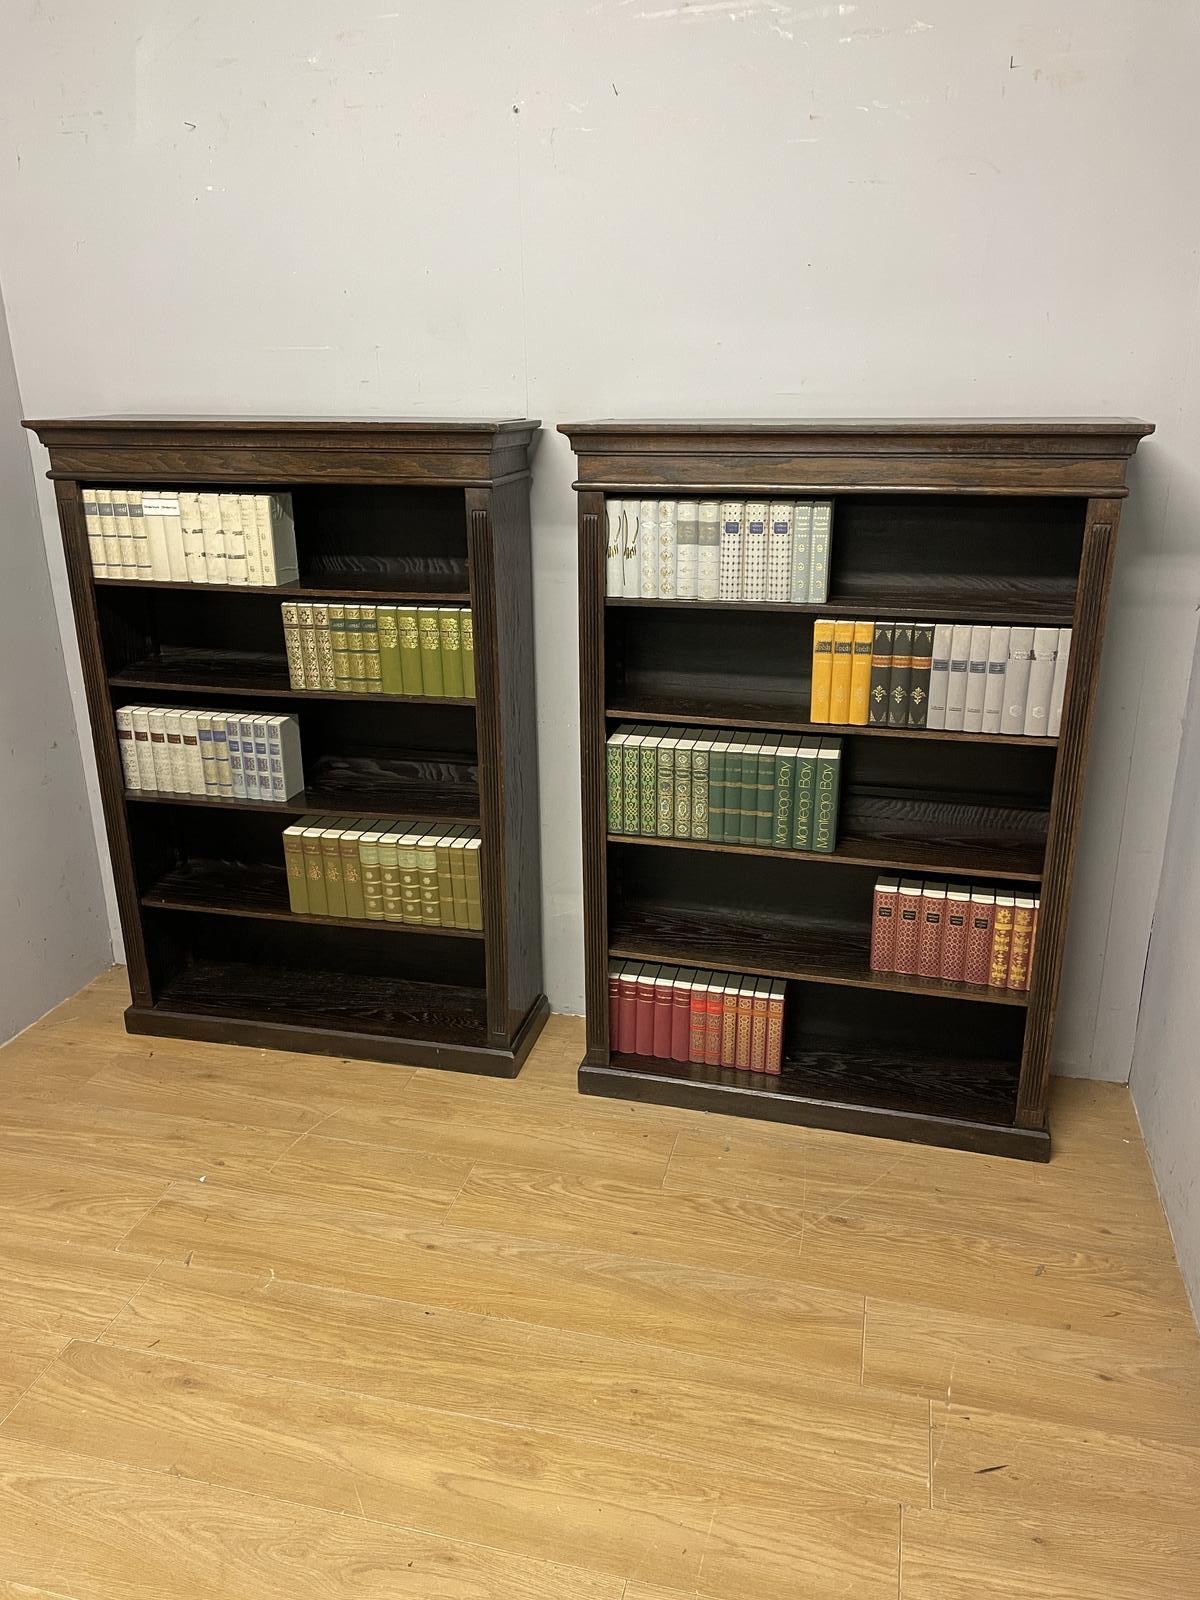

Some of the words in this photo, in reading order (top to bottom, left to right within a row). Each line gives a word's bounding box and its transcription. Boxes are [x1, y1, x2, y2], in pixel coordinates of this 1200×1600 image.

[778, 760, 794, 787] Bay
[798, 761, 815, 788] Bay
[819, 763, 836, 790] Bay
[775, 789, 793, 845] Montego
[796, 790, 814, 846] Montego
[816, 792, 835, 848] Montego
